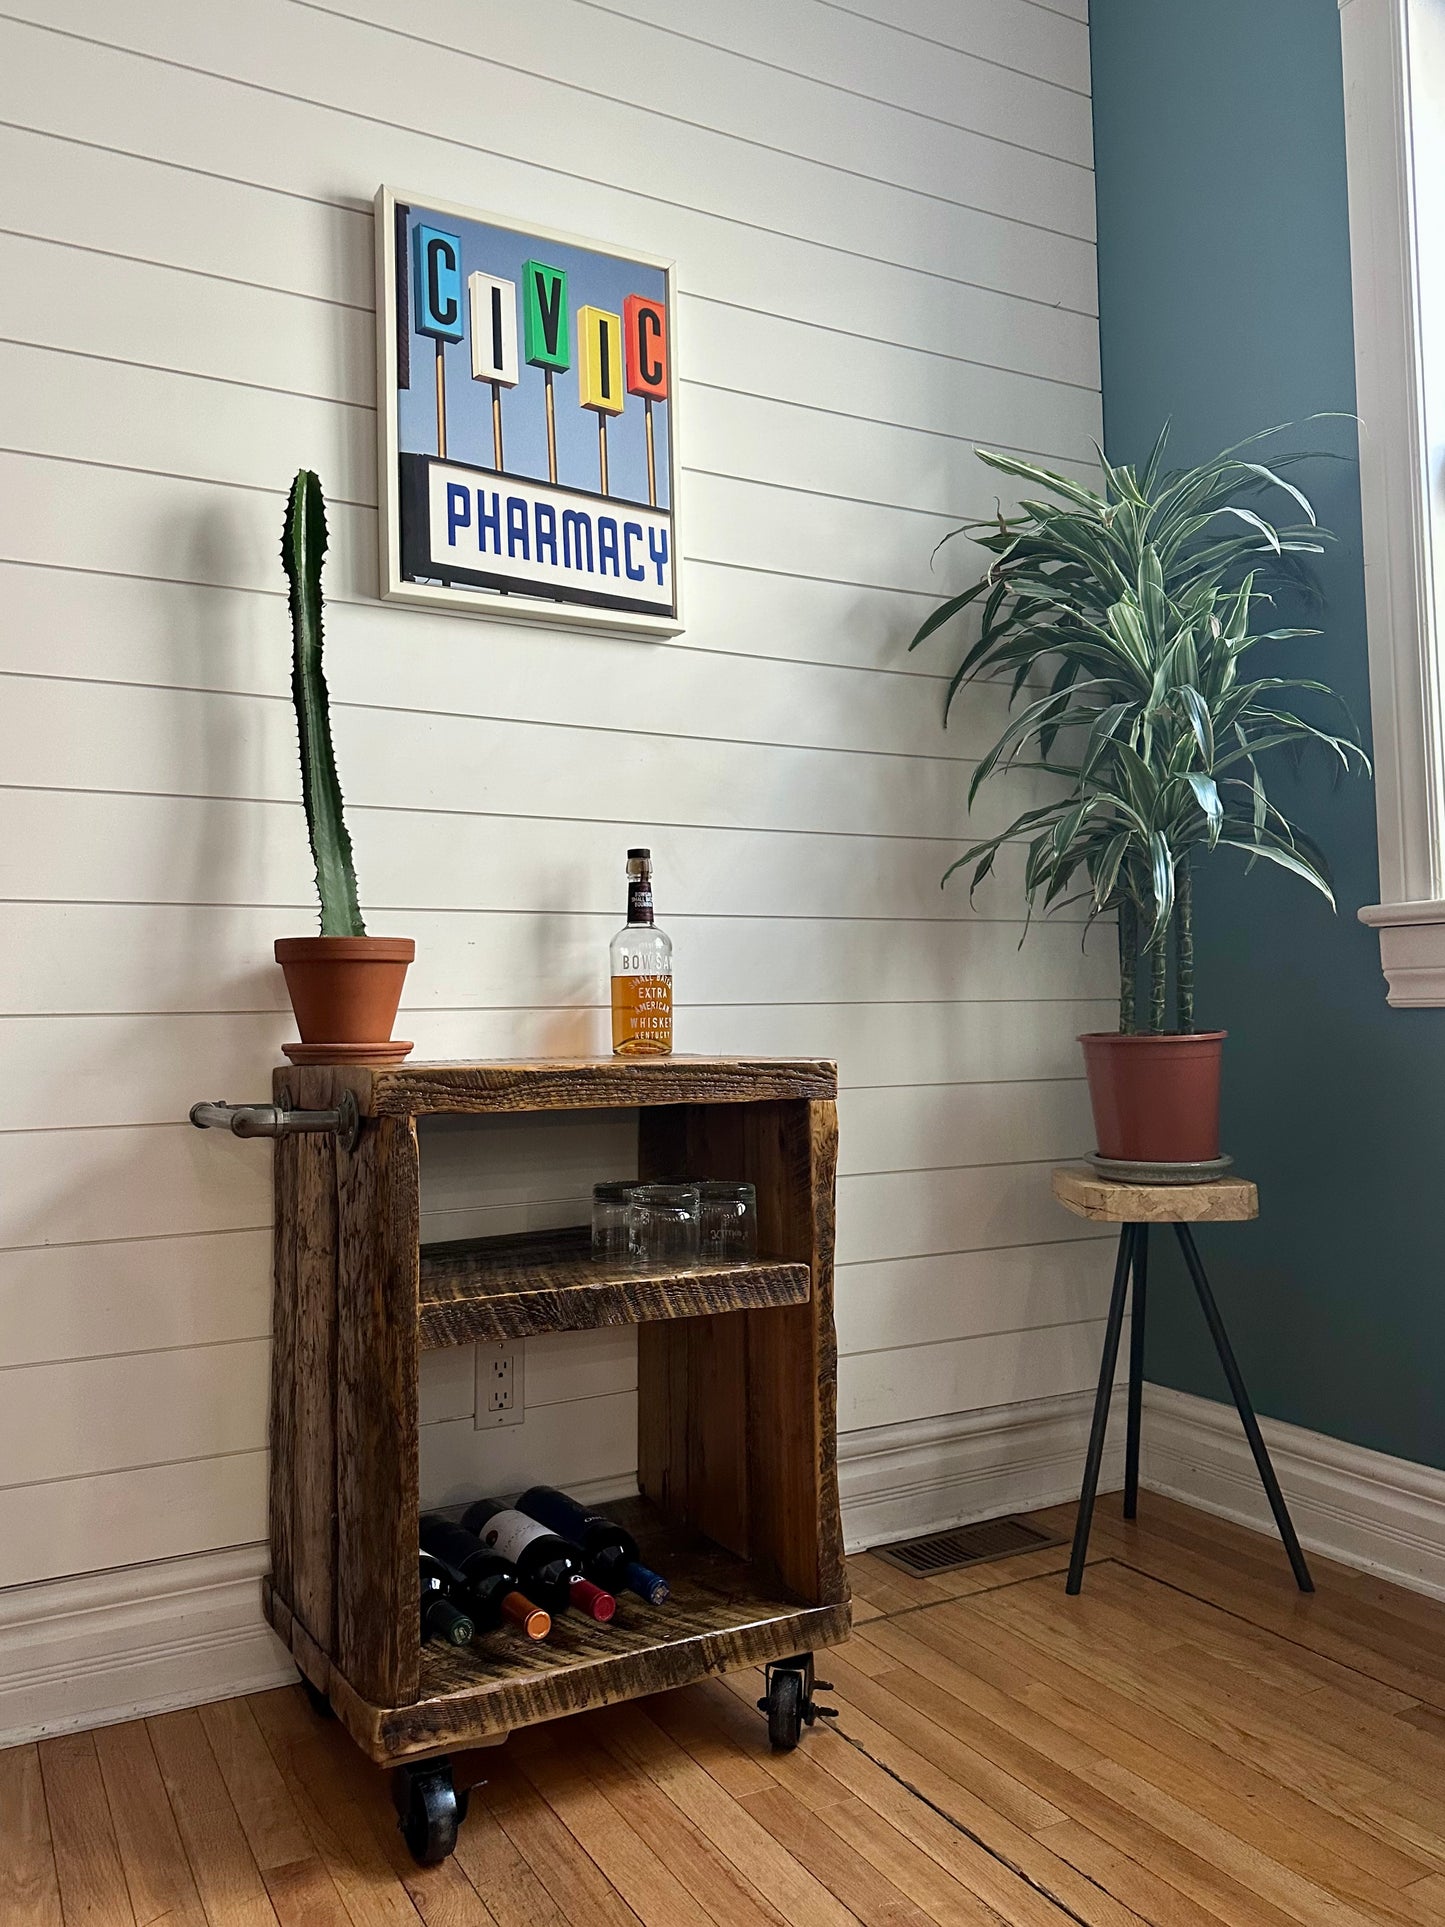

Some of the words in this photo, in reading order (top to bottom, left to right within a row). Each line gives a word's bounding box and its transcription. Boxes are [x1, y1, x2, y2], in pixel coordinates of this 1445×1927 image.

[427, 238, 662, 399] CIVIC
[446, 482, 669, 586] PHARMACY
[638, 987, 668, 999] EXTRA
[634, 1031, 670, 1040] KENTUCKY
